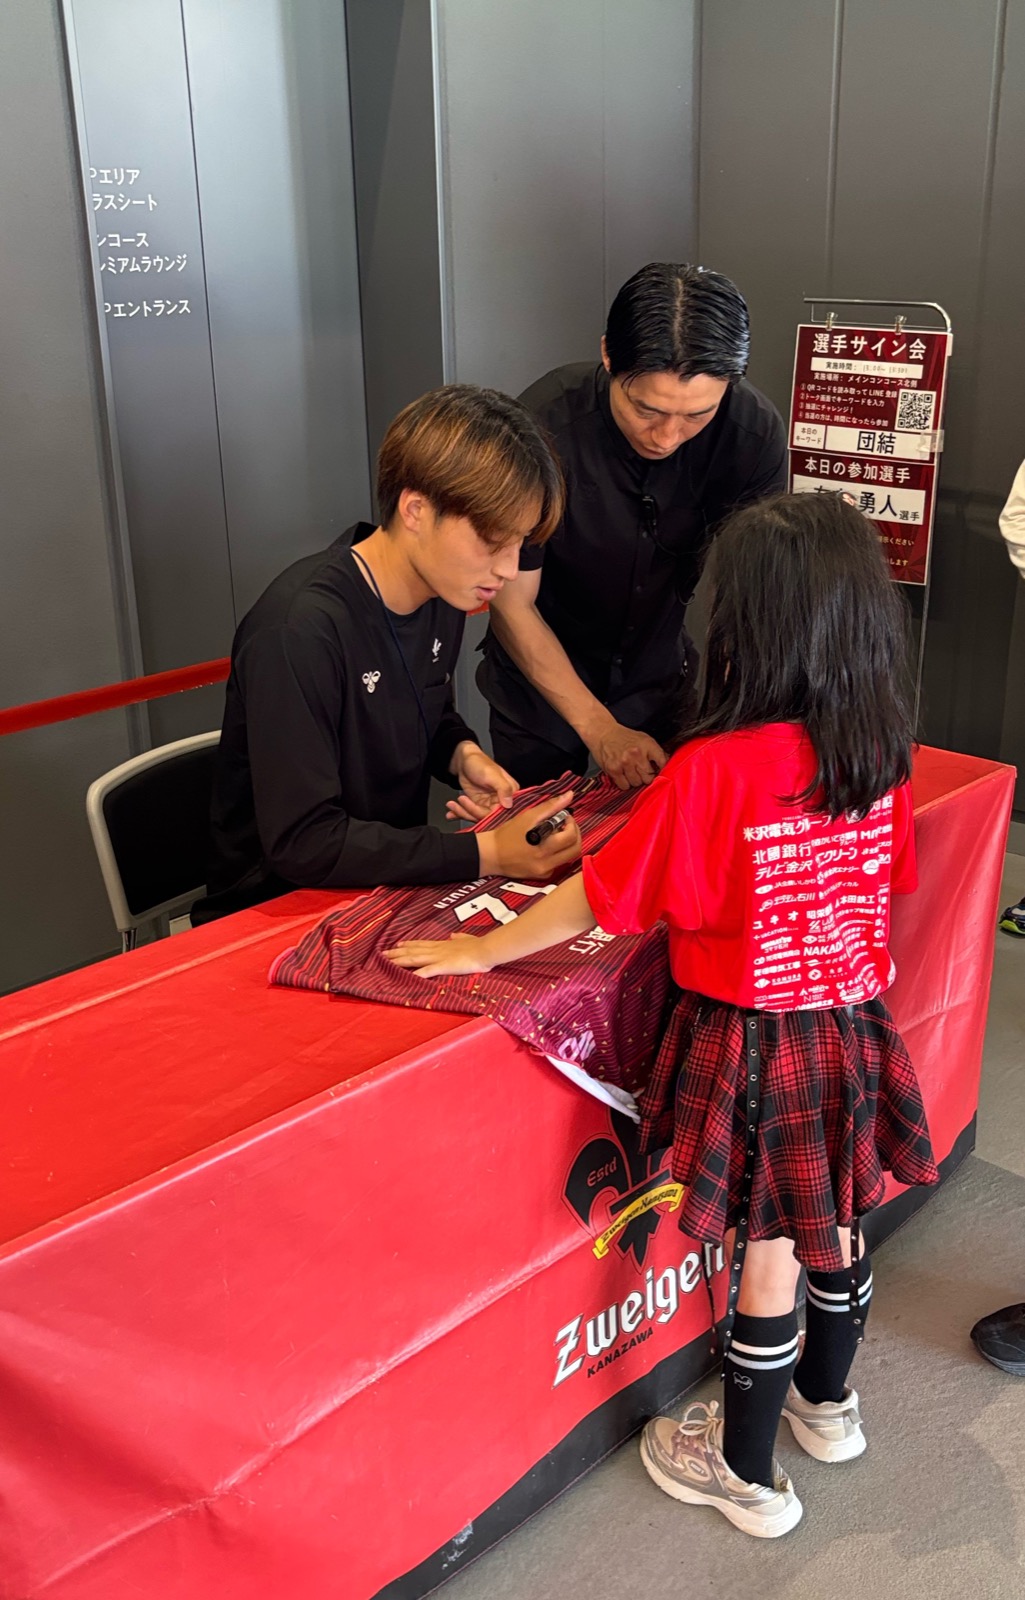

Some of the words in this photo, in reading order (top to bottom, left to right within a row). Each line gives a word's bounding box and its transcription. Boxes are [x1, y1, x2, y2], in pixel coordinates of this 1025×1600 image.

[92, 193, 157, 211] ラスシート
[812, 333, 927, 361] 選手サイン会
[857, 431, 897, 455] 団結
[805, 456, 911, 484] 本日の参加選手
[752, 842, 812, 865] 北國銀行
[754, 860, 813, 881] テレビ金沢
[552, 1242, 727, 1391] Zweigen
[586, 1326, 655, 1379] KANAZAWA
